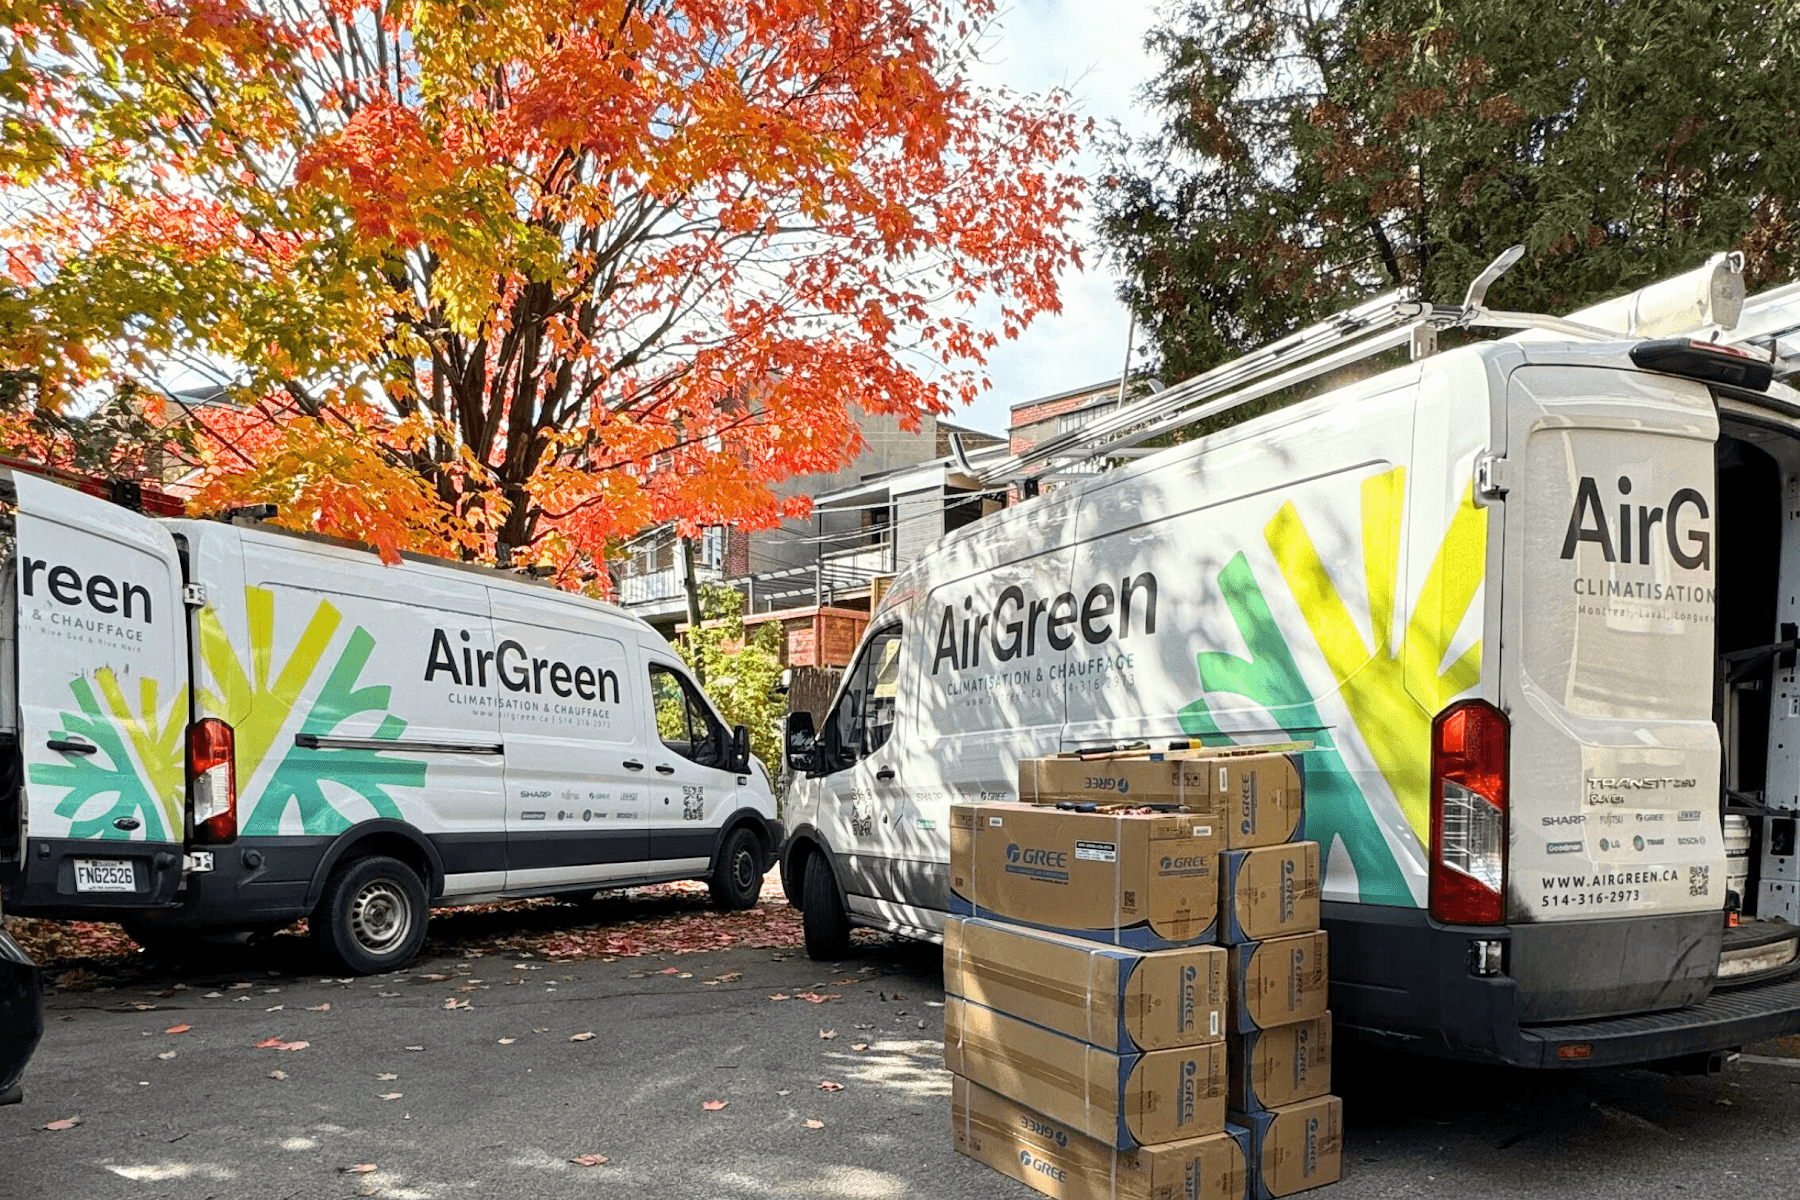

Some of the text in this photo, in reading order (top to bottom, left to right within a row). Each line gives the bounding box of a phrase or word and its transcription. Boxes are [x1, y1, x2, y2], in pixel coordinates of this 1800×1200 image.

[1560, 476, 1710, 571] AirG
[23, 556, 152, 624] reen
[1573, 578, 1715, 604] CLIMATISATION
[32, 608, 42, 620] &
[51, 613, 143, 641] CHAUFFAGE
[41, 627, 61, 637] Rive
[67, 632, 83, 641] Sud
[931, 571, 1158, 675] AirGreen
[424, 628, 620, 704] AirGreen
[947, 654, 1135, 696] CLIMATISATION & CHAUFFAGE
[448, 693, 610, 719] CLIMATISATION & CHAUFFAGE
[1084, 776, 1115, 791] GREE
[1240, 773, 1250, 816] GREE
[1587, 777, 1673, 790] TRANSIT
[1542, 815, 1586, 826] SHARP
[1644, 814, 1664, 822] GREE
[1023, 848, 1068, 868] GREE
[1174, 856, 1208, 869] GREE
[78, 867, 132, 883] FNG2526
[1542, 870, 1678, 889] WWW.AIRGREEN.CA
[1286, 877, 1294, 920] GREE
[1542, 890, 1640, 907] 514-316-2973
[1185, 984, 1194, 1030] GREE
[1185, 1078, 1194, 1124] GREE
[1021, 1115, 1055, 1139] GREE
[1309, 1133, 1317, 1174] GREE
[1033, 1158, 1068, 1183] GREE
